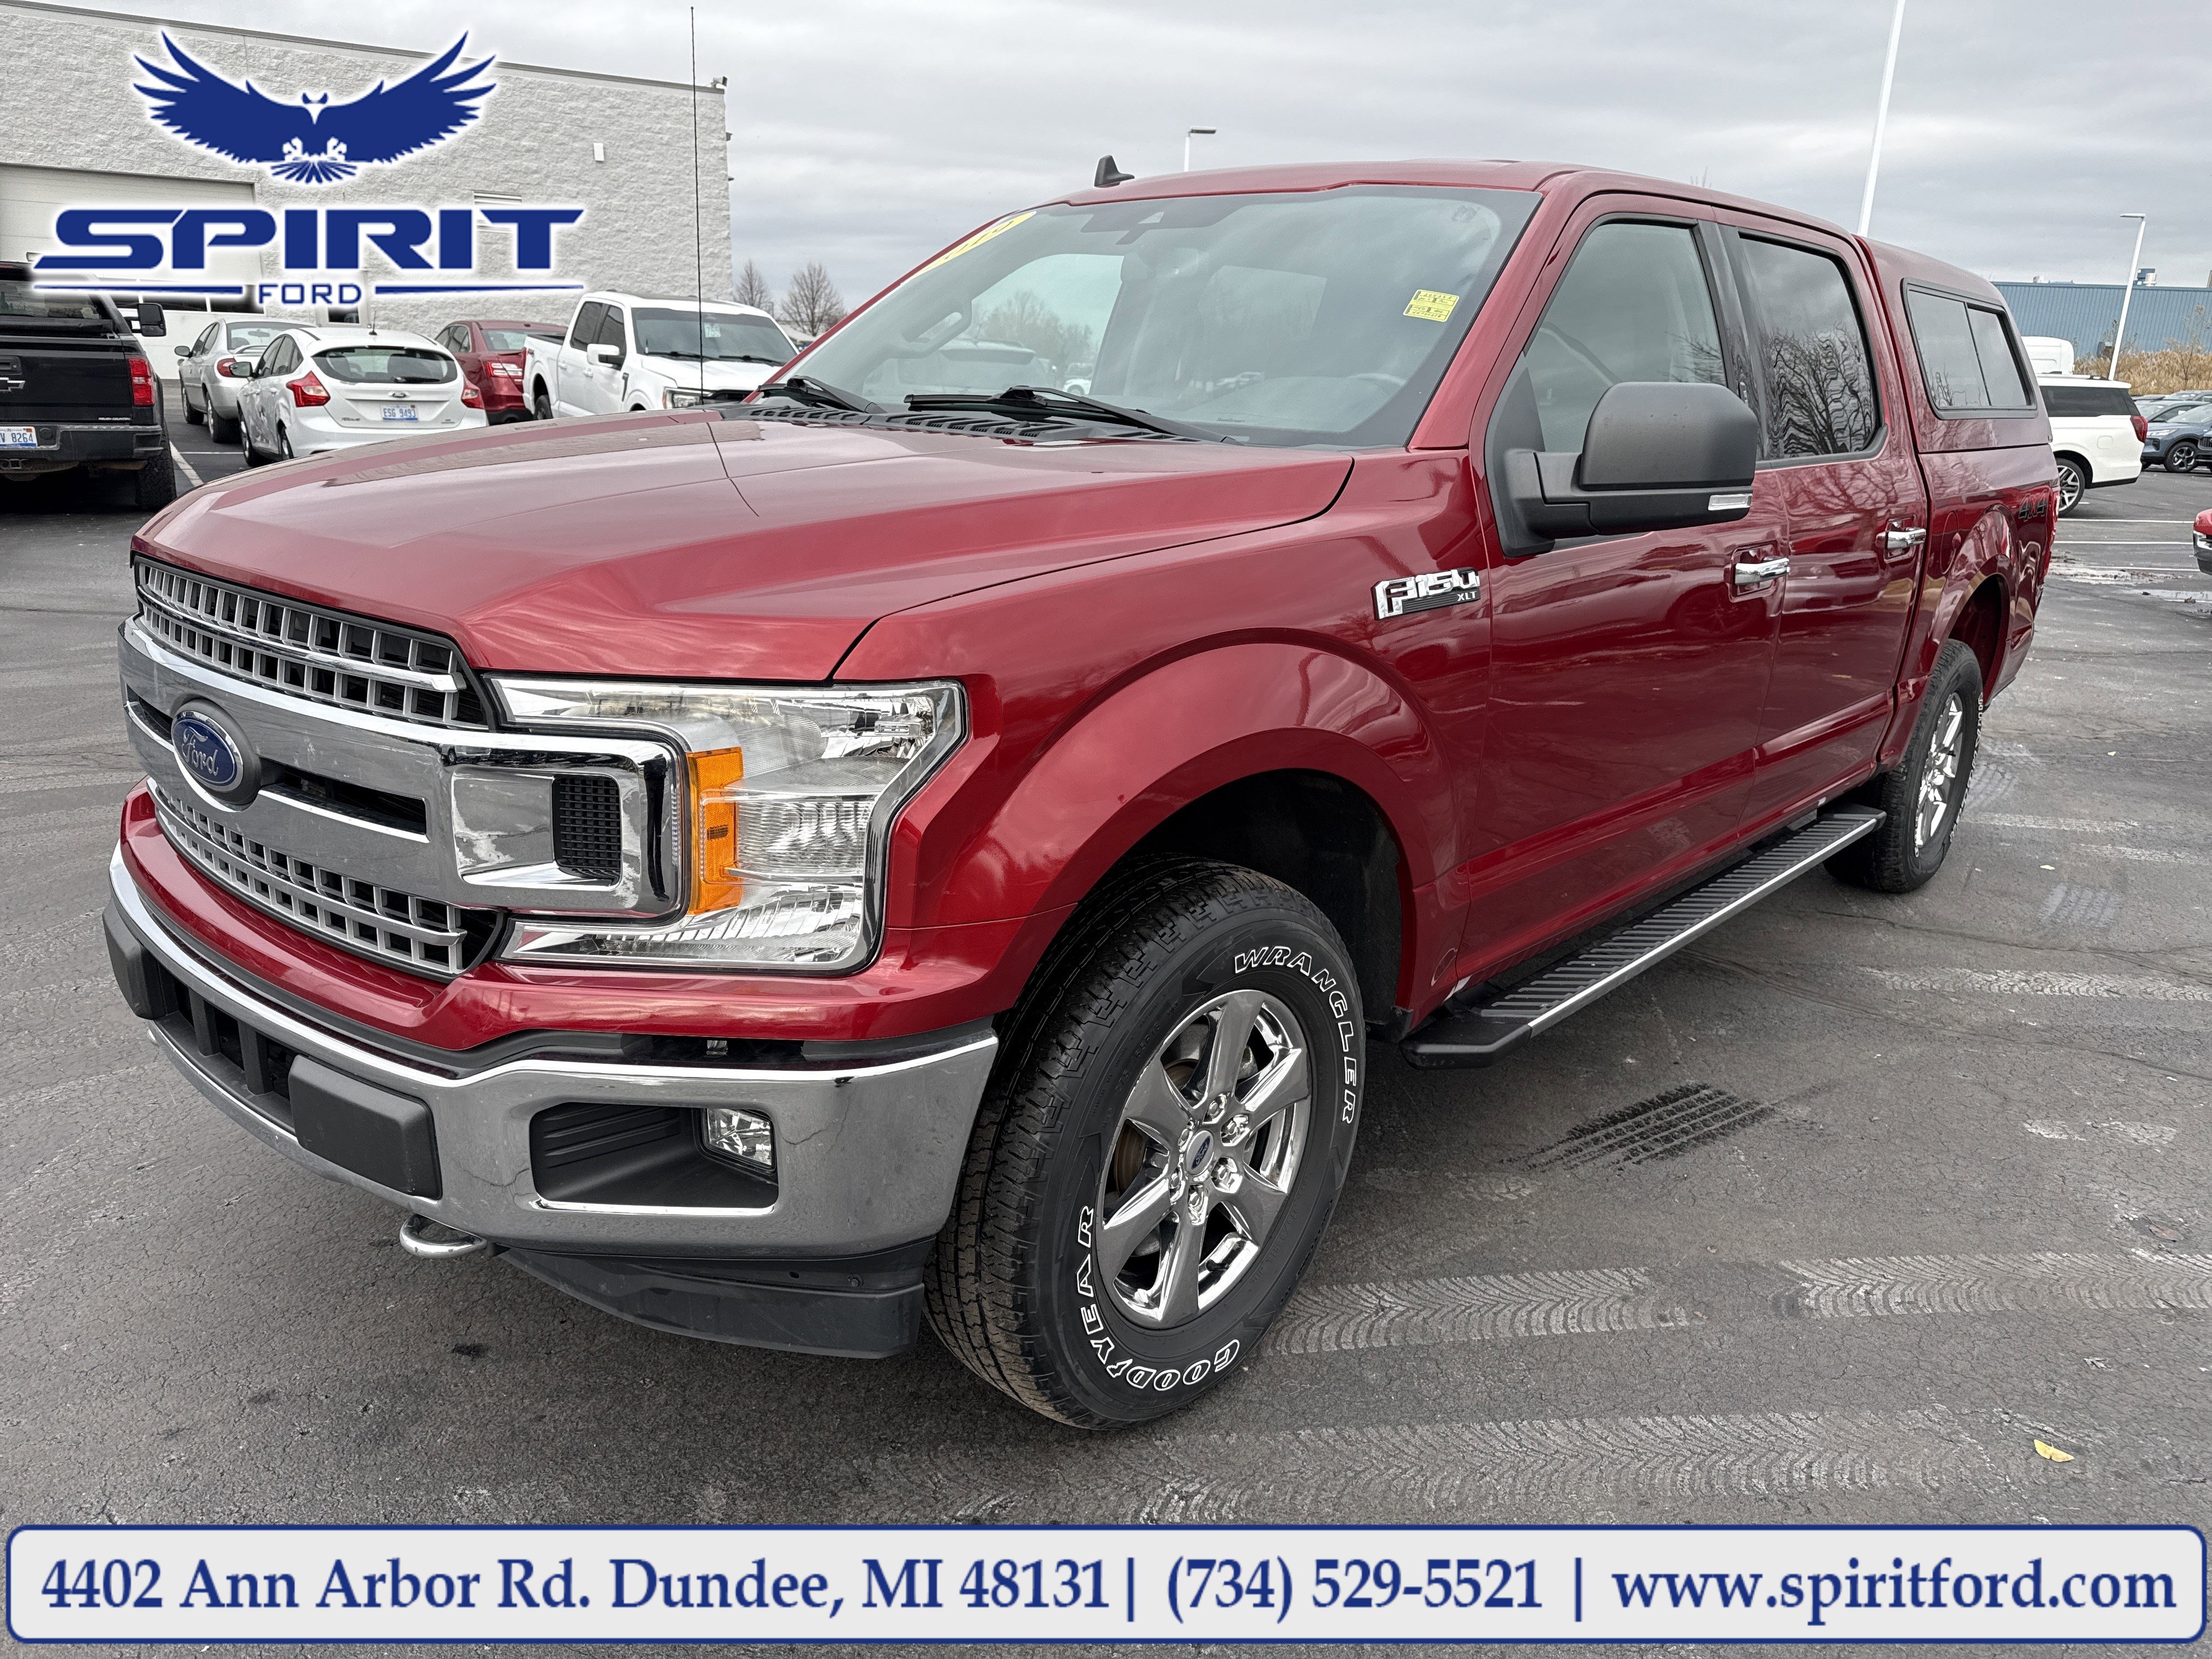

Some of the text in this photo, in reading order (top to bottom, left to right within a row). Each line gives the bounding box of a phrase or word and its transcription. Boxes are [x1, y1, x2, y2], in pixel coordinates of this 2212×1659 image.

[11, 432, 33, 443] 8264
[1457, 590, 1477, 602] XLT
[181, 726, 219, 777] Ford
[1234, 945, 1357, 1130] WRANGLER
[1076, 1205, 1240, 1391] GOODYEAR
